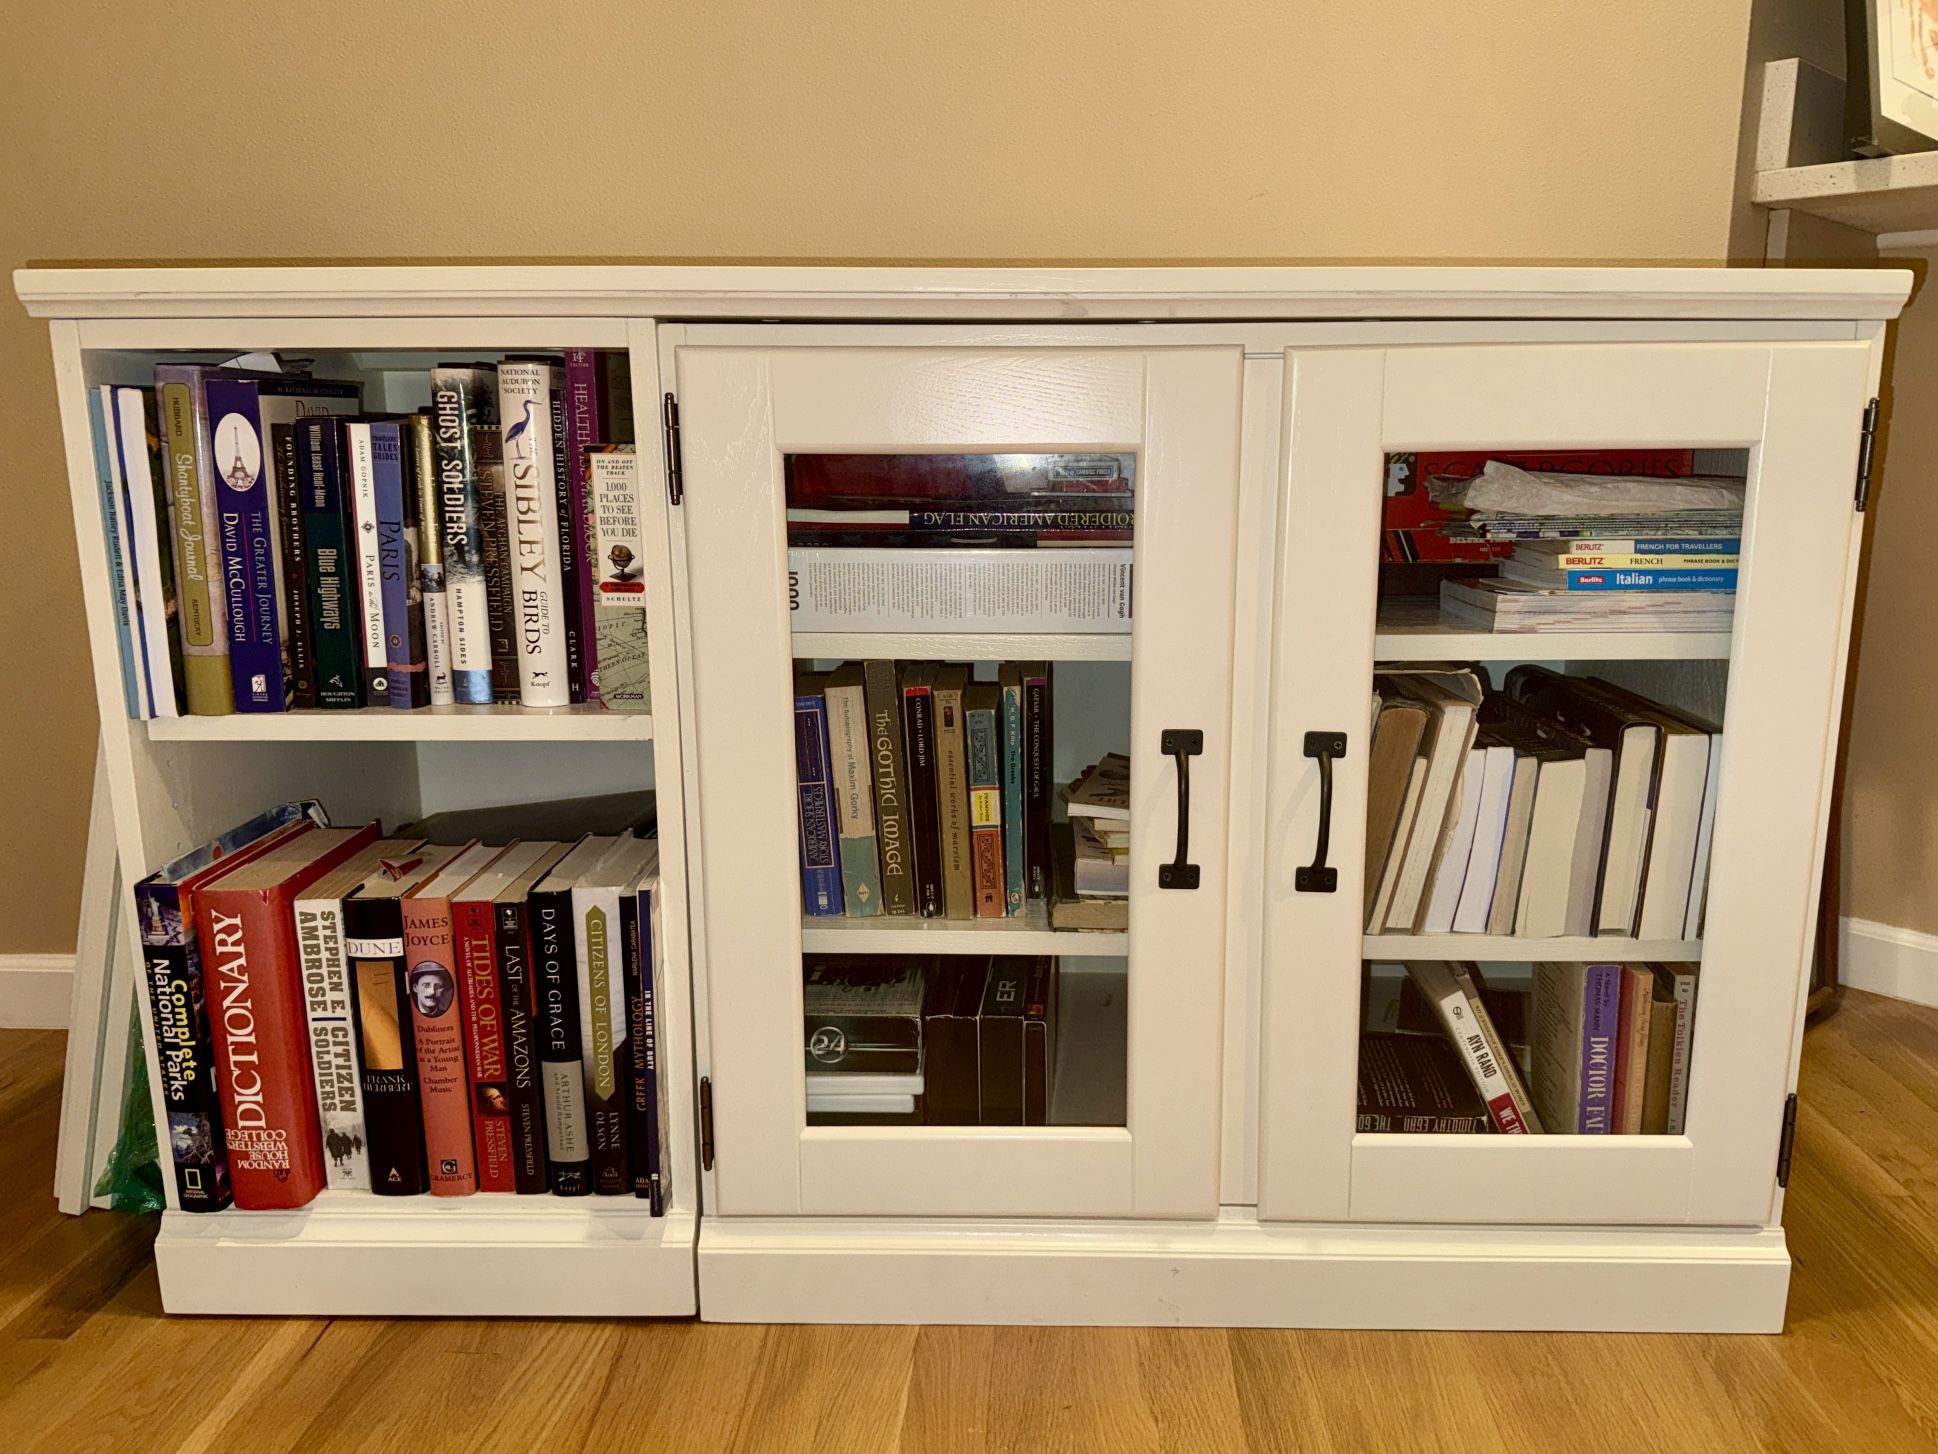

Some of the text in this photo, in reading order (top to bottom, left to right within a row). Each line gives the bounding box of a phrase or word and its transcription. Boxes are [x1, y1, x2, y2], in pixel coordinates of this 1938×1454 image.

[500, 368, 541, 376] NATIONAL
[502, 378, 540, 386] AUDUBON
[172, 397, 182, 437] HUBBARD
[308, 424, 324, 471] William Least
[374, 453, 398, 461] GUIDES
[361, 466, 369, 499] GOPNIK
[436, 390, 468, 545] GHOST SOLDIERS
[552, 401, 572, 572] HIDDEN HISTORY FLORIDA
[285, 437, 301, 562] FOUNDING BROTHERS
[600, 494, 634, 503] PLACES
[606, 482, 627, 493] 1,000
[176, 453, 204, 582] Shantyboat Journal
[513, 463, 547, 583] SIBLEY
[600, 505, 633, 514] TO SEE
[600, 516, 637, 526] BEFORE
[924, 512, 1056, 526] AMERICAN FLAG
[223, 512, 239, 552] DAVID
[380, 520, 400, 582] PARIS
[478, 470, 504, 632] STEVEN PRESSFIELD
[600, 528, 638, 538] YOU DIE
[252, 512, 272, 646] THE GREATER JOURNEY
[1566, 557, 1604, 565] BERLITZ
[1616, 573, 1653, 585] Italian
[1630, 558, 1663, 566] FRENCH
[1658, 576, 1677, 584] phrase
[1698, 576, 1724, 584] dictionary
[317, 548, 342, 630] Blue Highways
[366, 555, 380, 648] PARIS MOON
[192, 598, 202, 637] KENTUCKY
[456, 588, 467, 664] HAMPTON SIDES
[522, 589, 542, 655] BIRDS
[540, 591, 550, 634] GUIDE TO
[1118, 602, 1126, 618] Gogh
[429, 598, 440, 670] ANDREW CARROLL
[568, 630, 578, 668] CLARK
[297, 642, 305, 669] ELLIS
[530, 680, 550, 688] Knopf
[915, 698, 923, 728] CONRAD
[1032, 688, 1040, 780] CAESAR THE CONQUEST OF
[918, 756, 926, 766] JIM
[948, 750, 958, 789] essential
[847, 762, 858, 820] Maxim Gorky
[949, 792, 960, 820] works
[404, 916, 448, 930] JAMES
[406, 932, 450, 948] JOYCE
[298, 911, 328, 1012] AMBROSE
[320, 910, 346, 1014] STEPHEN E.
[348, 940, 401, 955] DUNE
[505, 946, 522, 984] LAST
[512, 984, 518, 994] OF
[542, 909, 566, 1050] DAYS OF GRACE
[644, 990, 652, 998] IN
[210, 908, 266, 1130] DICTIONARY
[472, 934, 502, 1078] TIDES OF WAR
[590, 919, 611, 1088] CITIZENS OF LONDON
[644, 1002, 652, 1015] THE
[1592, 972, 1603, 1032] THOMAS MANN
[1677, 1000, 1688, 1020] The
[153, 959, 188, 1100] National Parks
[171, 979, 198, 1081] Complete
[417, 1024, 454, 1032] Dubliners
[426, 1037, 456, 1046] Portrait
[646, 1038, 653, 1048] OF
[1674, 1023, 1686, 1065] Tolkien
[430, 1064, 448, 1072] Man
[434, 1055, 459, 1064] Young
[438, 1046, 460, 1054] Artist
[510, 1009, 532, 1089] AMAZONS
[632, 996, 646, 1112] GREEK MYTHOLOGY
[646, 1052, 654, 1070] DUTY
[1466, 1034, 1498, 1079] AYN RAND
[1586, 1036, 1610, 1100] DOCTOR
[312, 1026, 338, 1112] SOLDIERS
[331, 1026, 357, 1112] CITIZEN
[367, 1075, 406, 1084] FRANK
[423, 1076, 458, 1084] Chamber
[1672, 1068, 1682, 1108] Reader
[560, 1073, 574, 1152] ARTHUR ASHE
[596, 1111, 606, 1150] OLSON
[610, 1112, 620, 1150] LYNNE
[1373, 1116, 1478, 1132] TIMOTHY THE
[1498, 1106, 1516, 1124] WE
[225, 1130, 286, 1142] COLLEGE
[248, 1150, 289, 1160] HOUSE
[484, 1121, 499, 1178] PRESSFIELD
[496, 1120, 508, 1162] STEVEN
[522, 1104, 535, 1176] STEVEN PRESSFIELD
[238, 1160, 290, 1169] RANDOM
[430, 1172, 472, 1182] GRAMERCY
